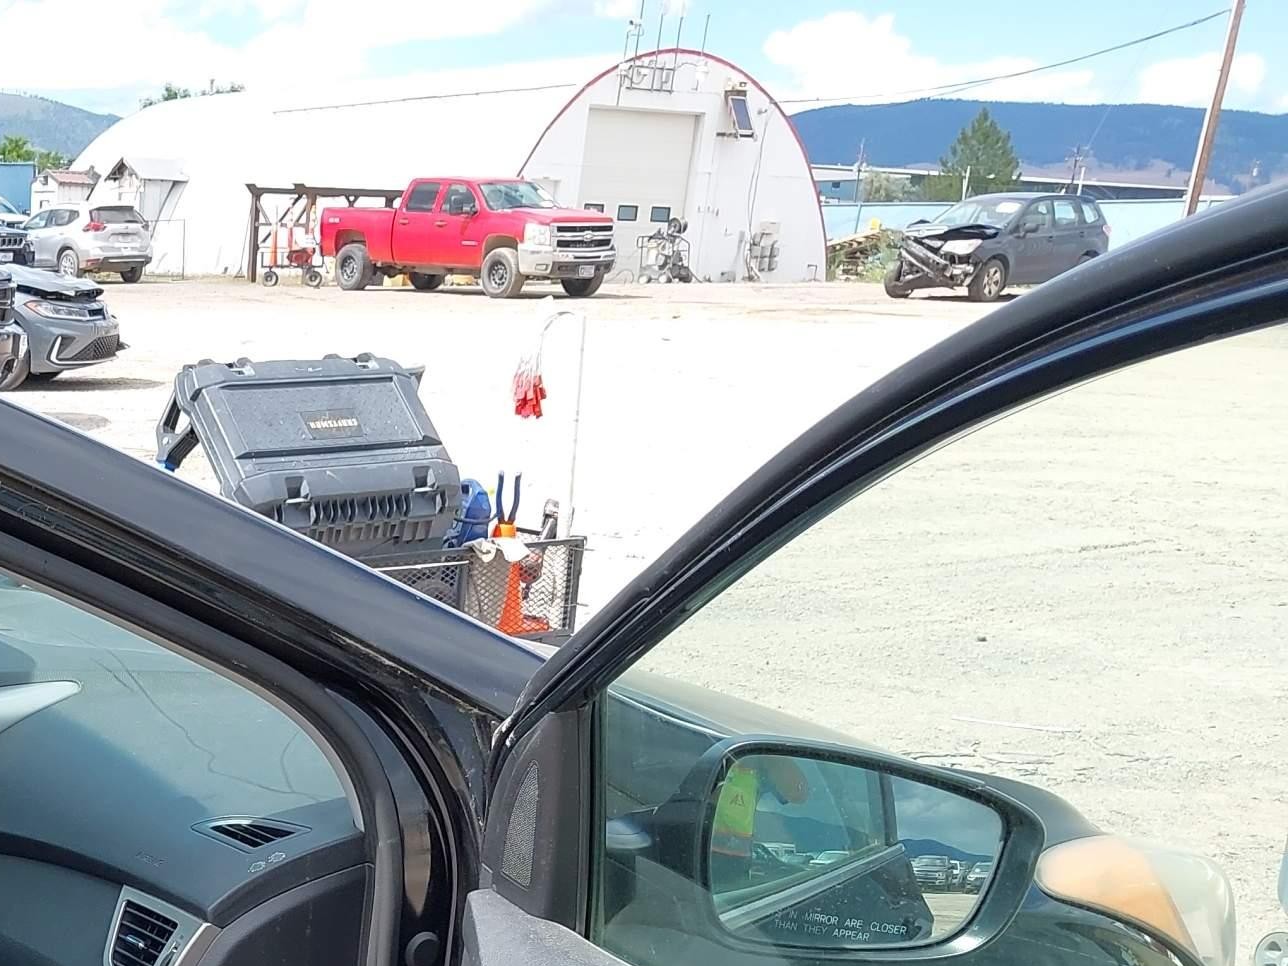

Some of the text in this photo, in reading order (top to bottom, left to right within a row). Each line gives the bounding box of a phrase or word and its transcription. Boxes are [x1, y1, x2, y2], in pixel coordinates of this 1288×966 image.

[774, 919, 871, 942] THAN THEY APPEAR
[804, 911, 839, 926] MIRROR
[844, 918, 864, 930] ARE
[870, 921, 908, 936] CLOSER
